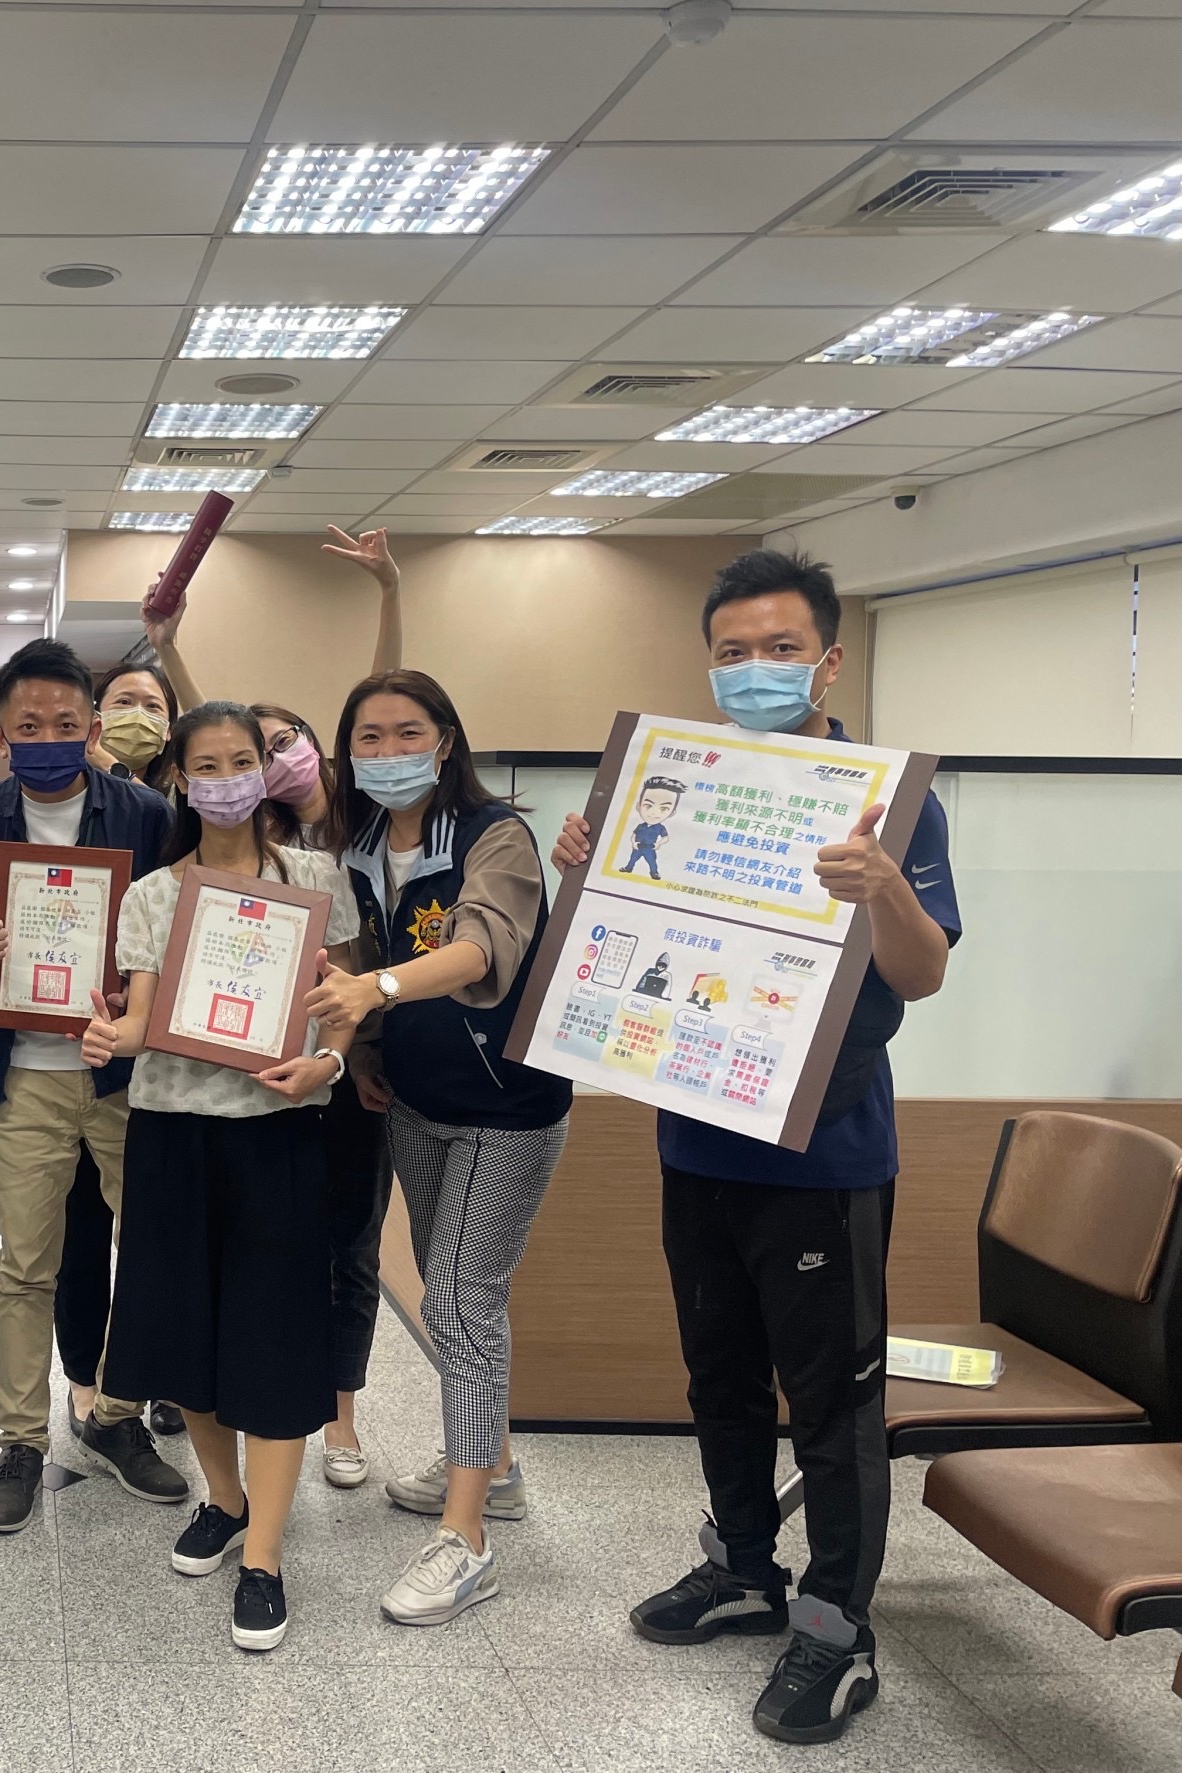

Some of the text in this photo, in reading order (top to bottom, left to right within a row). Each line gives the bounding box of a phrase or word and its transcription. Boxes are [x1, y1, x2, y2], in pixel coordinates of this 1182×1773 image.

[714, 798, 815, 827] 獲利來源不明或
[692, 810, 828, 846] 獲利率顯不合理之情形
[716, 830, 791, 856] 應避免投資
[694, 847, 803, 880] 請勿輕信網友介紹
[683, 861, 804, 895] 來路不明之投資管道
[39, 887, 79, 896] 新北市政府
[228, 916, 271, 930] 新北市政府
[663, 928, 722, 952] 假投資詐騙
[578, 986, 596, 997] Step1
[629, 1000, 649, 1012] Step2
[683, 1015, 703, 1027] Step3
[740, 1030, 762, 1043] Step4
[801, 1252, 825, 1265] NIKE
